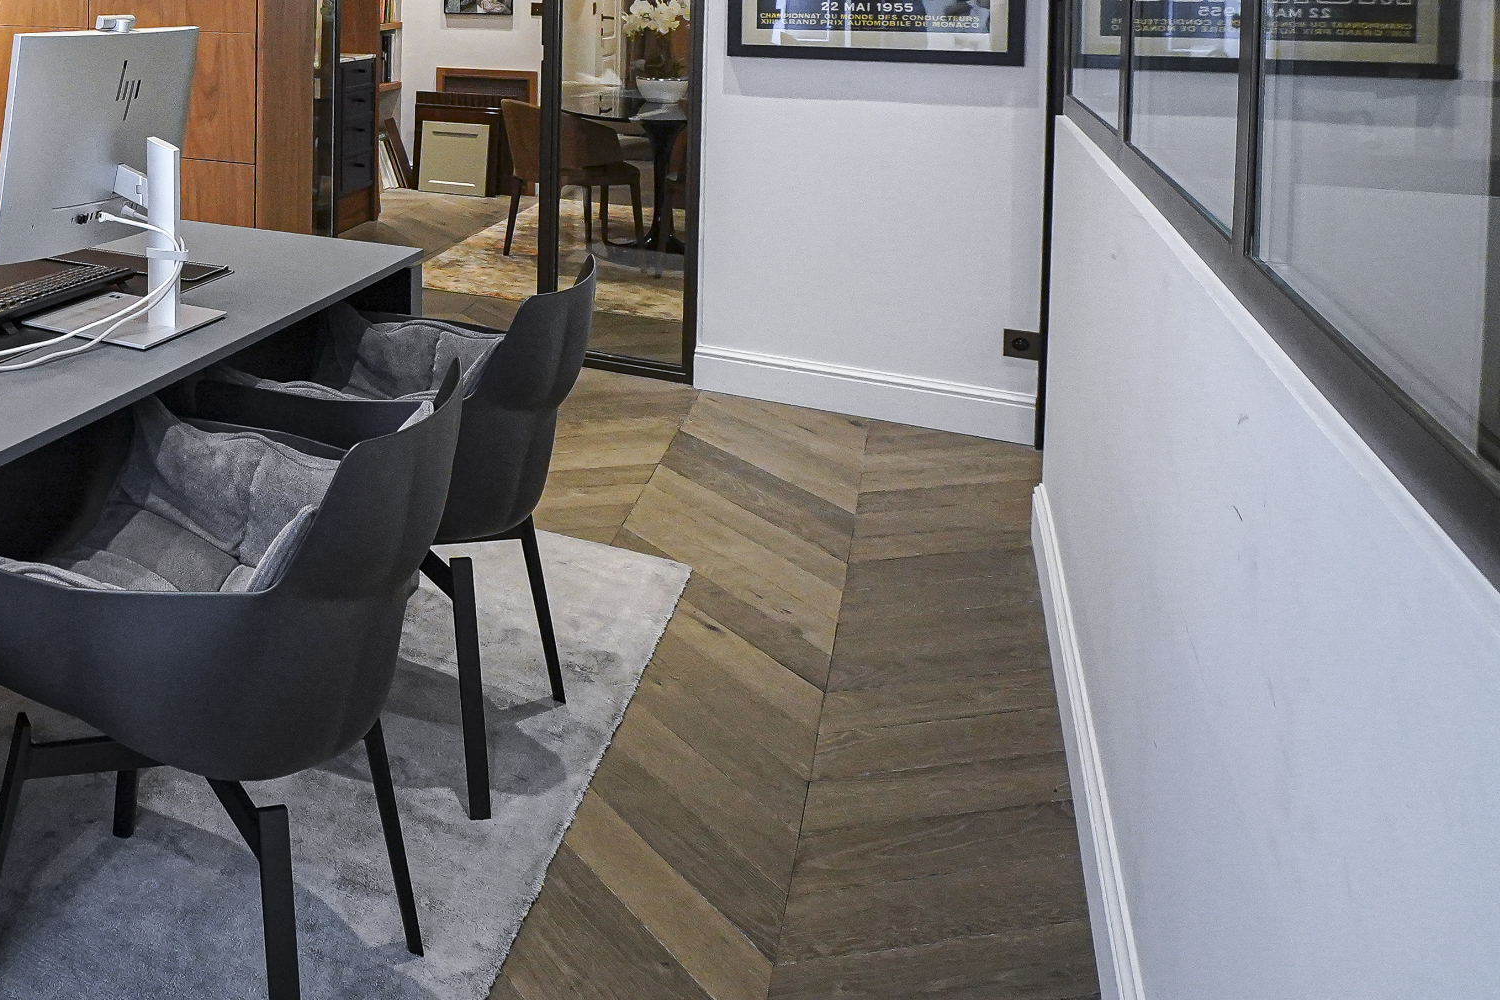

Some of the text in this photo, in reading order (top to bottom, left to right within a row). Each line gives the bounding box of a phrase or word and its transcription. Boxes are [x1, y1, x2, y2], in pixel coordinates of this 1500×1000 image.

[821, 1, 914, 12] 22 MAI 1955
[783, 18, 818, 26] GRAND
[931, 21, 980, 29] MONACO
[901, 14, 980, 23] CONDUCTEURS
